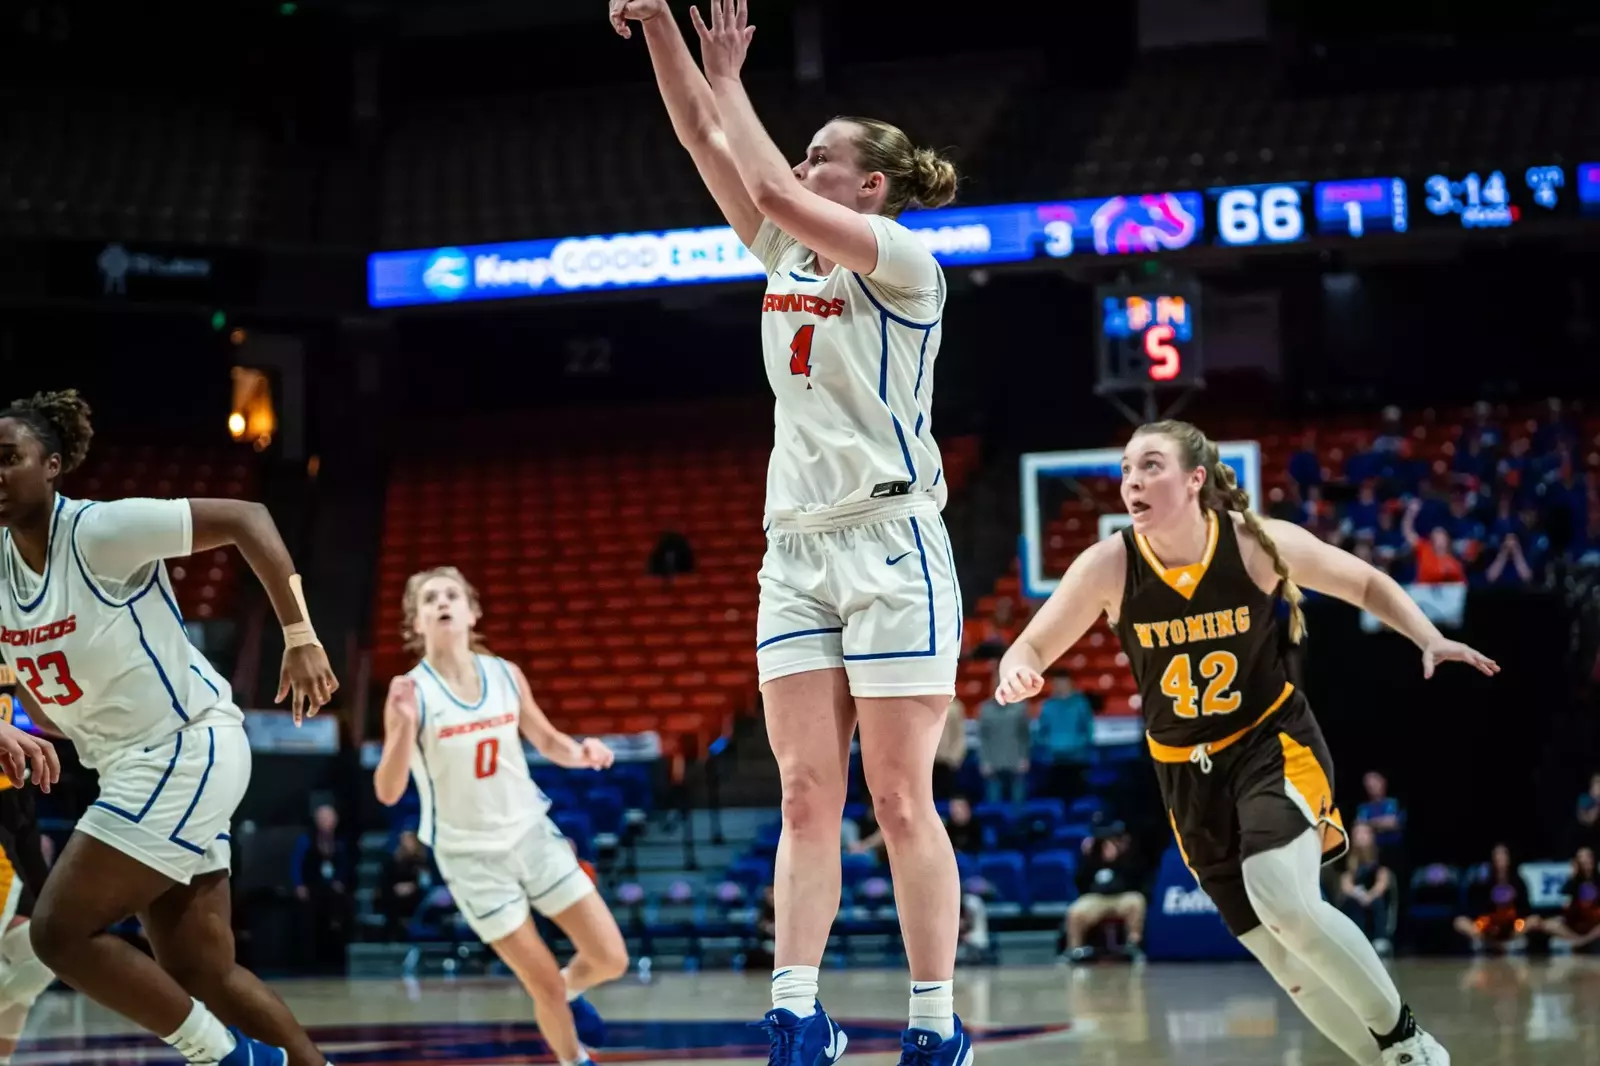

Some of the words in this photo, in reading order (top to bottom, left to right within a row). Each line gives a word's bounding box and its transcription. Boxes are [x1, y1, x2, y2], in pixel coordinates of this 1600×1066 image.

[1216, 184, 1305, 245] 66
[1425, 171, 1508, 214] 3:14
[1043, 220, 1073, 257] 3
[1342, 200, 1363, 237] 1
[762, 293, 845, 319] RONCOS
[789, 324, 815, 389] 4
[1143, 324, 1181, 381] 5
[1133, 605, 1251, 649] WYOMING
[16, 650, 84, 706] 23
[1160, 650, 1242, 719] 42
[474, 736, 500, 780] 0
